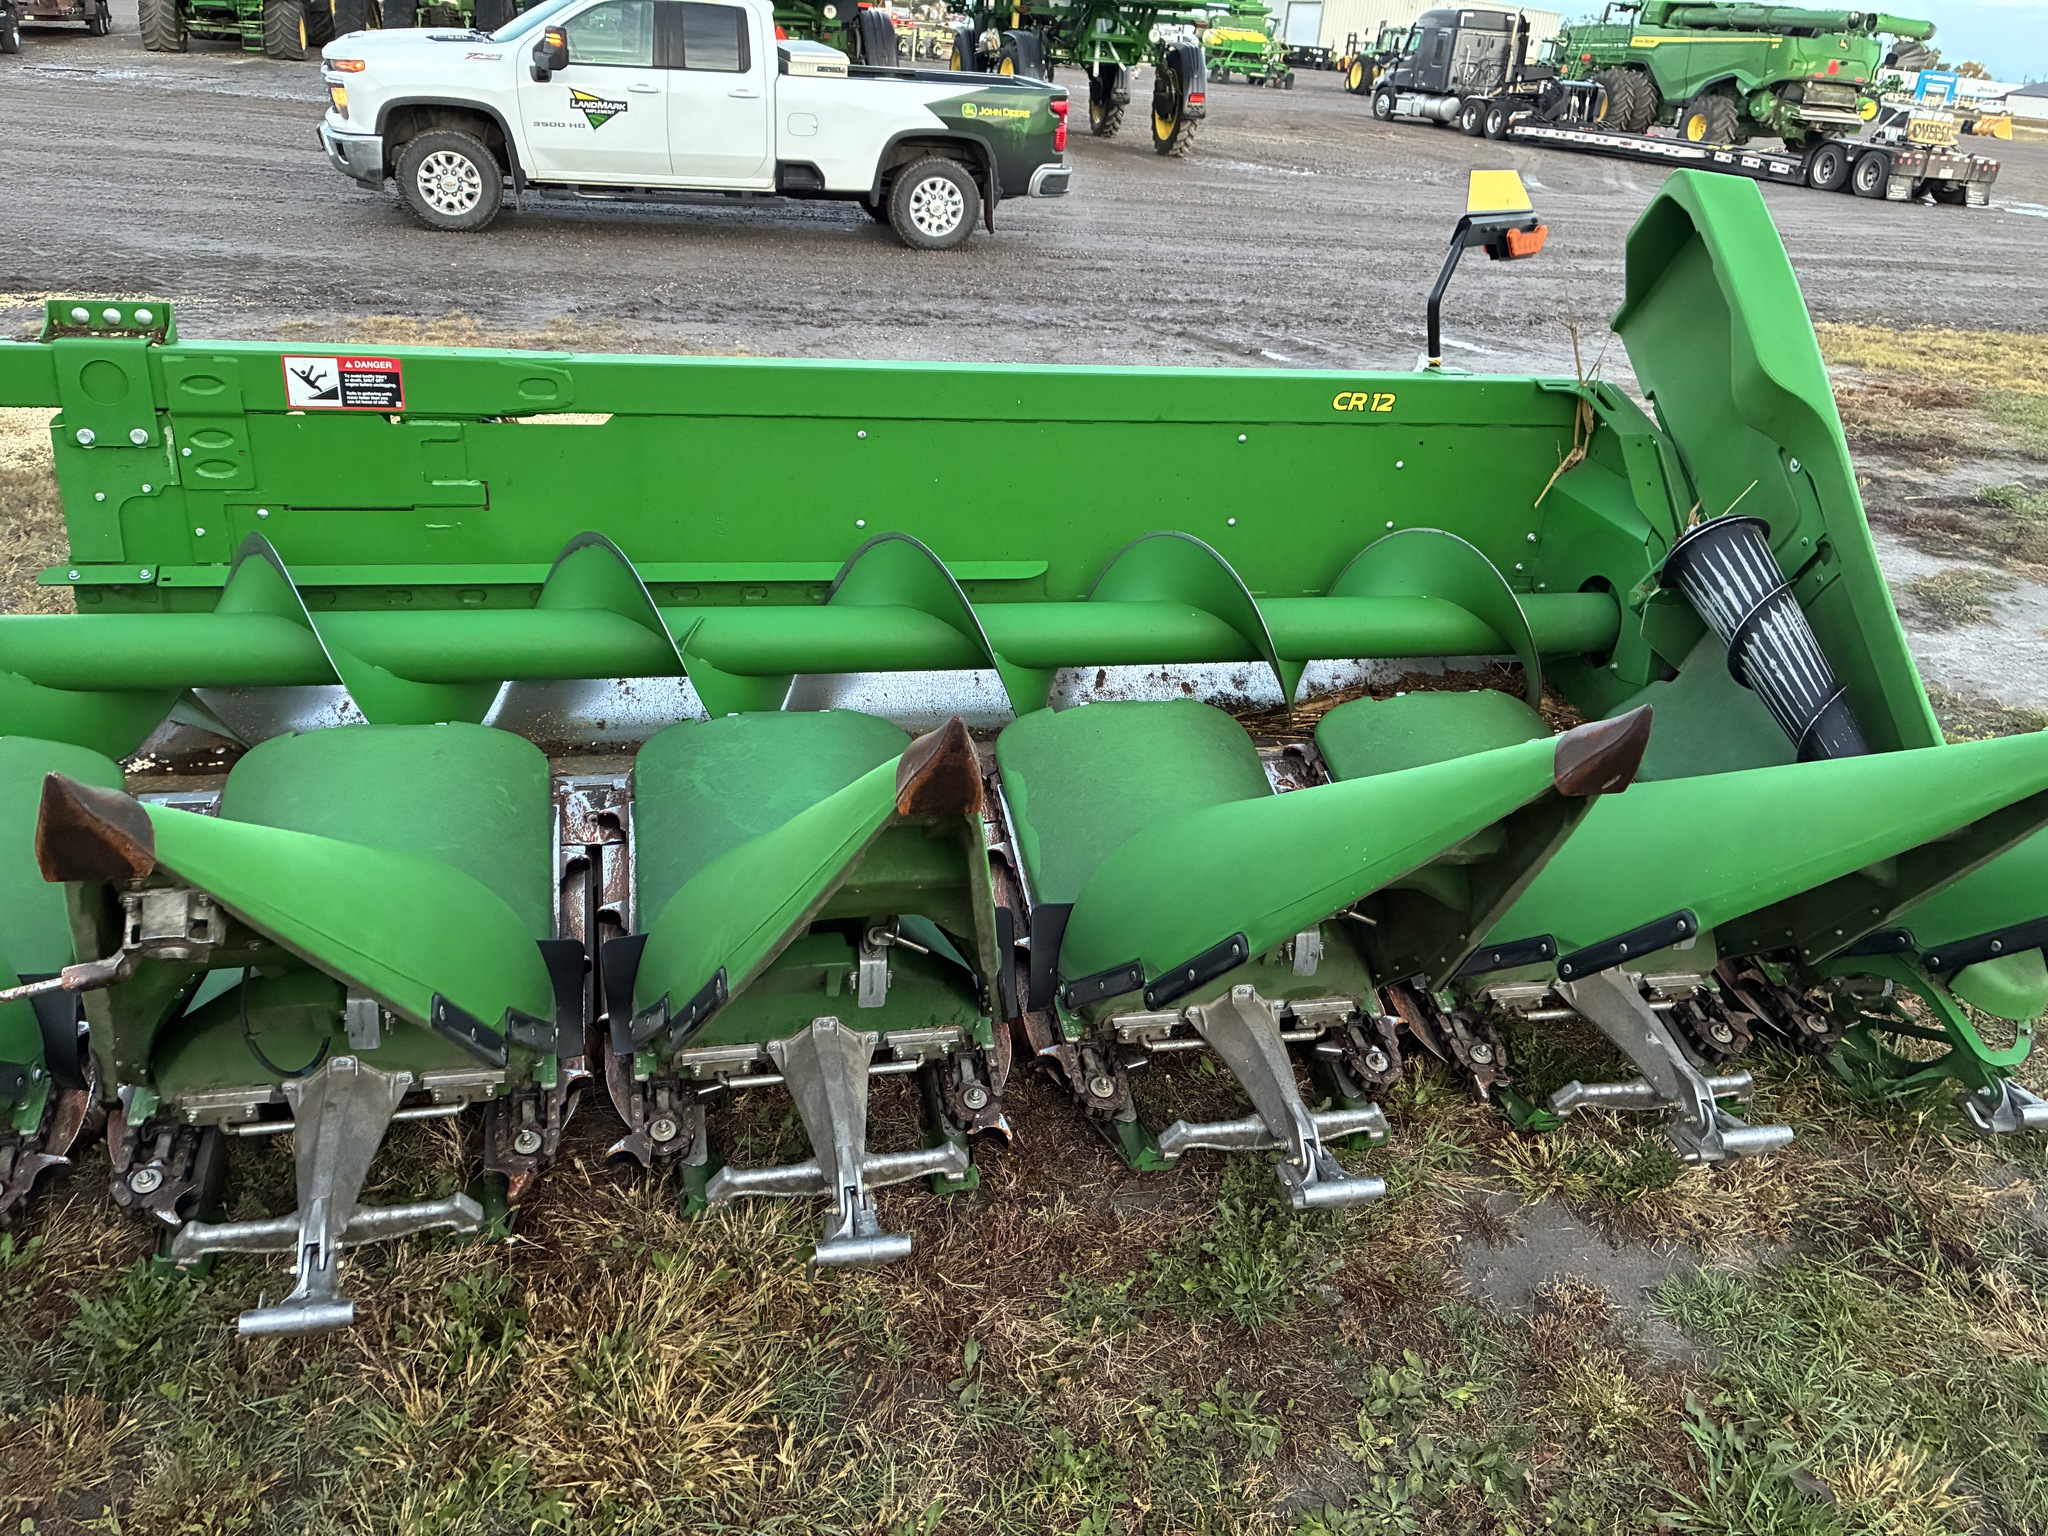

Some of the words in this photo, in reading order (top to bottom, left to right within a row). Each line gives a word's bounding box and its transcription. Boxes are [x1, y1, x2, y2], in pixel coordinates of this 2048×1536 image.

[979, 106, 1002, 117] JOHN
[1003, 107, 1031, 118] DEERE
[354, 360, 393, 369] DANGER
[1332, 391, 1369, 411] CR
[1370, 392, 1397, 413] 12
